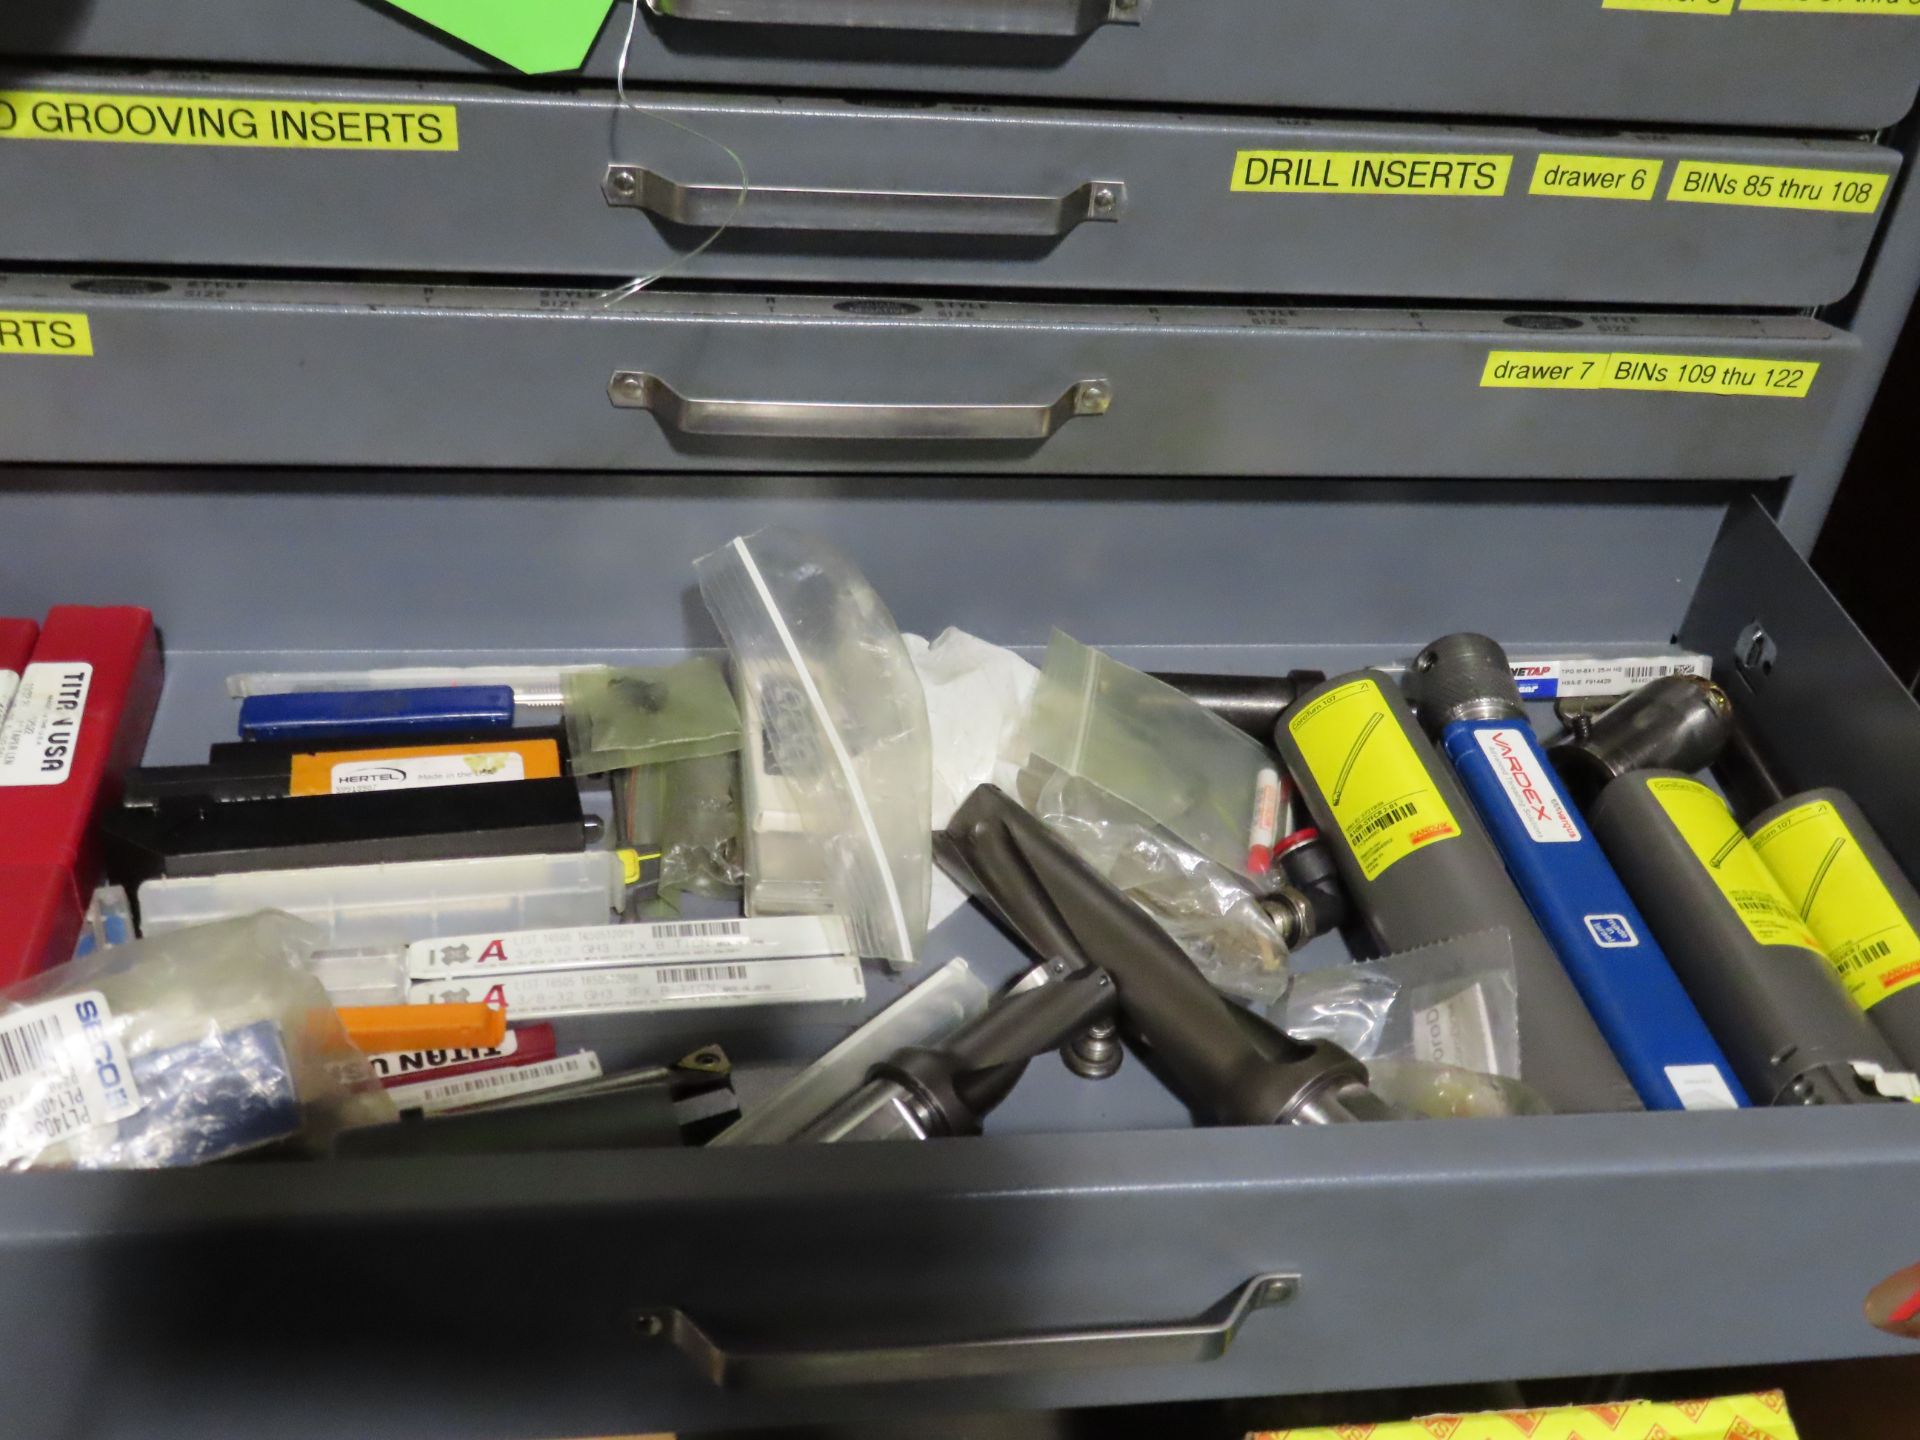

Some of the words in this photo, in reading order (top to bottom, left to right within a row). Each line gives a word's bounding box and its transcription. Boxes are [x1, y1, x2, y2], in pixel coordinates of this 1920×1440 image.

[32, 102, 258, 139] GROOVING
[270, 110, 443, 144] INSERTS
[1245, 158, 1339, 186] DRILL
[1352, 160, 1497, 189] INSERTS
[1543, 165, 1626, 189] drawer
[1630, 169, 1648, 190] 6
[1683, 171, 1738, 195] BINs
[1743, 175, 1775, 197] 85
[1778, 178, 1823, 201] thru
[1831, 181, 1873, 203] 108
[0, 319, 75, 348] RTS
[1494, 360, 1574, 380] drawer
[1581, 361, 1595, 380] 7
[1614, 361, 1668, 382] BINs
[1678, 364, 1717, 384] 109
[1721, 367, 1755, 386] thu
[1765, 368, 1804, 389] 122
[41, 732, 70, 772] USA
[339, 773, 400, 784] HERTEL
[1492, 732, 1552, 821] VARDEX
